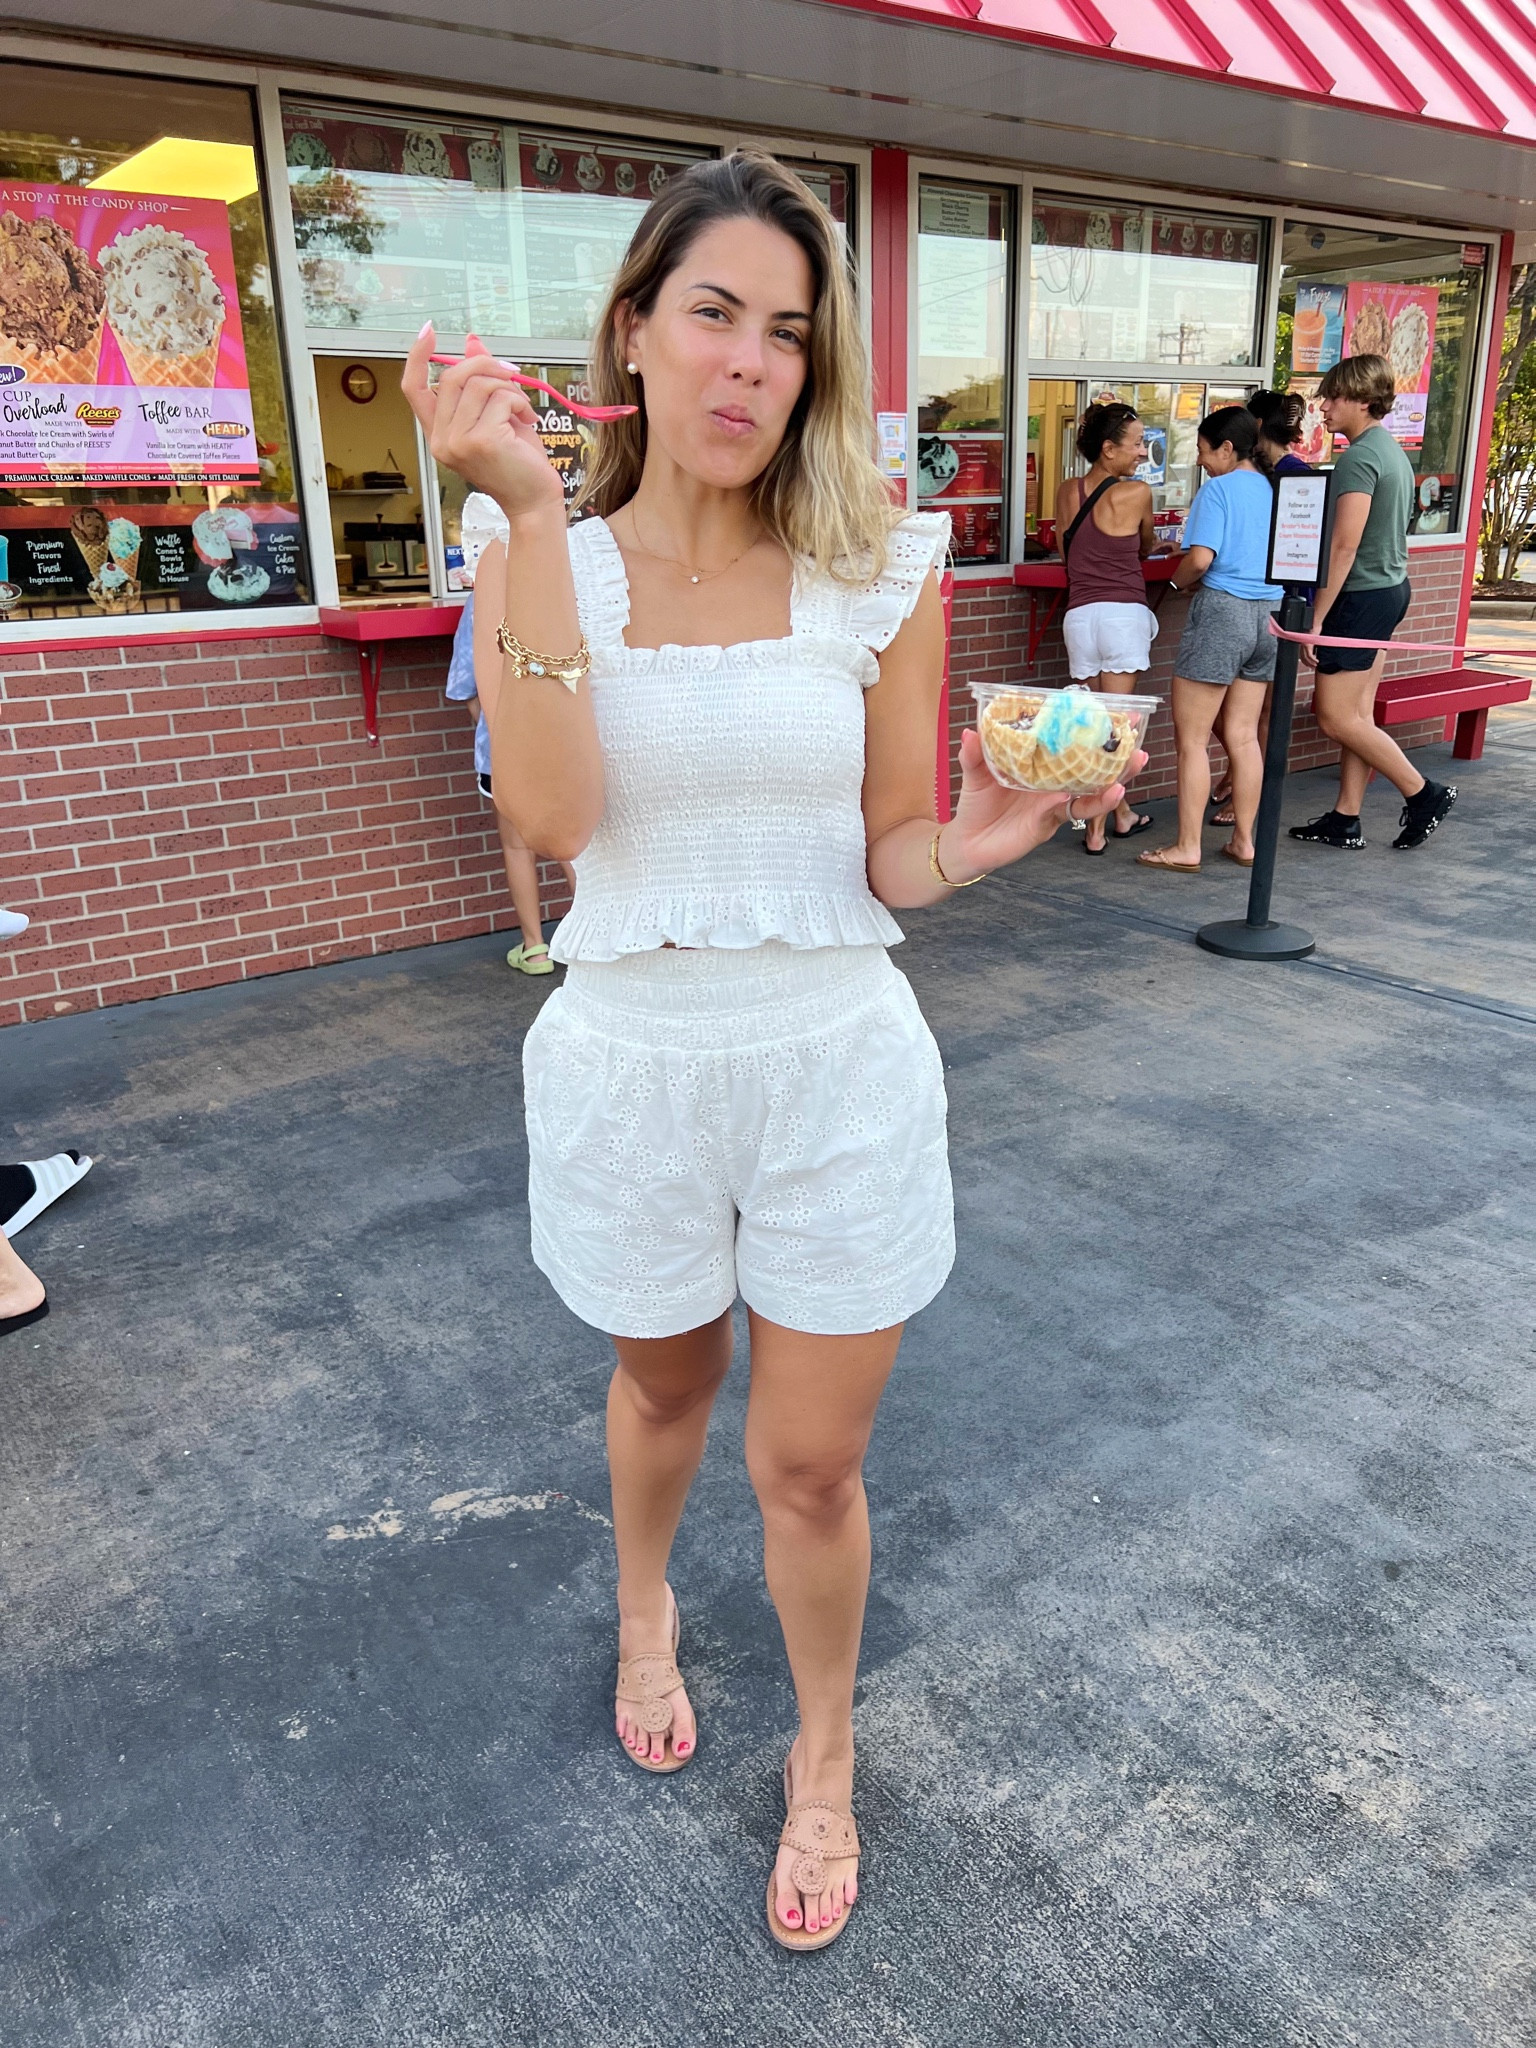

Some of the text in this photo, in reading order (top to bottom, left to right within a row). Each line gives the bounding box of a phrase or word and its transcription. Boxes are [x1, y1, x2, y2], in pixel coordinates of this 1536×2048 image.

[2, 191, 169, 213] A STOP AT THE CANDY SHOP
[1457, 269, 1479, 289] 252
[0, 366, 17, 383] ew!
[3, 391, 32, 402] CUP
[567, 384, 592, 402] PIC
[4, 393, 122, 422] Overload Reese's
[138, 400, 213, 424] Toffee BAR
[88, 430, 107, 438] Swirls
[206, 423, 247, 437] HEATH
[40, 451, 56, 460] Cups
[5, 474, 37, 482] PREMIUM
[129, 473, 151, 481] CONES
[155, 533, 181, 547] Waffle
[269, 533, 295, 544] Custom
[26, 541, 64, 551] Premium
[33, 552, 62, 560] Flavors
[275, 553, 295, 564] Cakes
[37, 562, 61, 574] Finest
[160, 561, 185, 576] Baked
[282, 565, 296, 574] Pies
[29, 576, 74, 586] Ingredients
